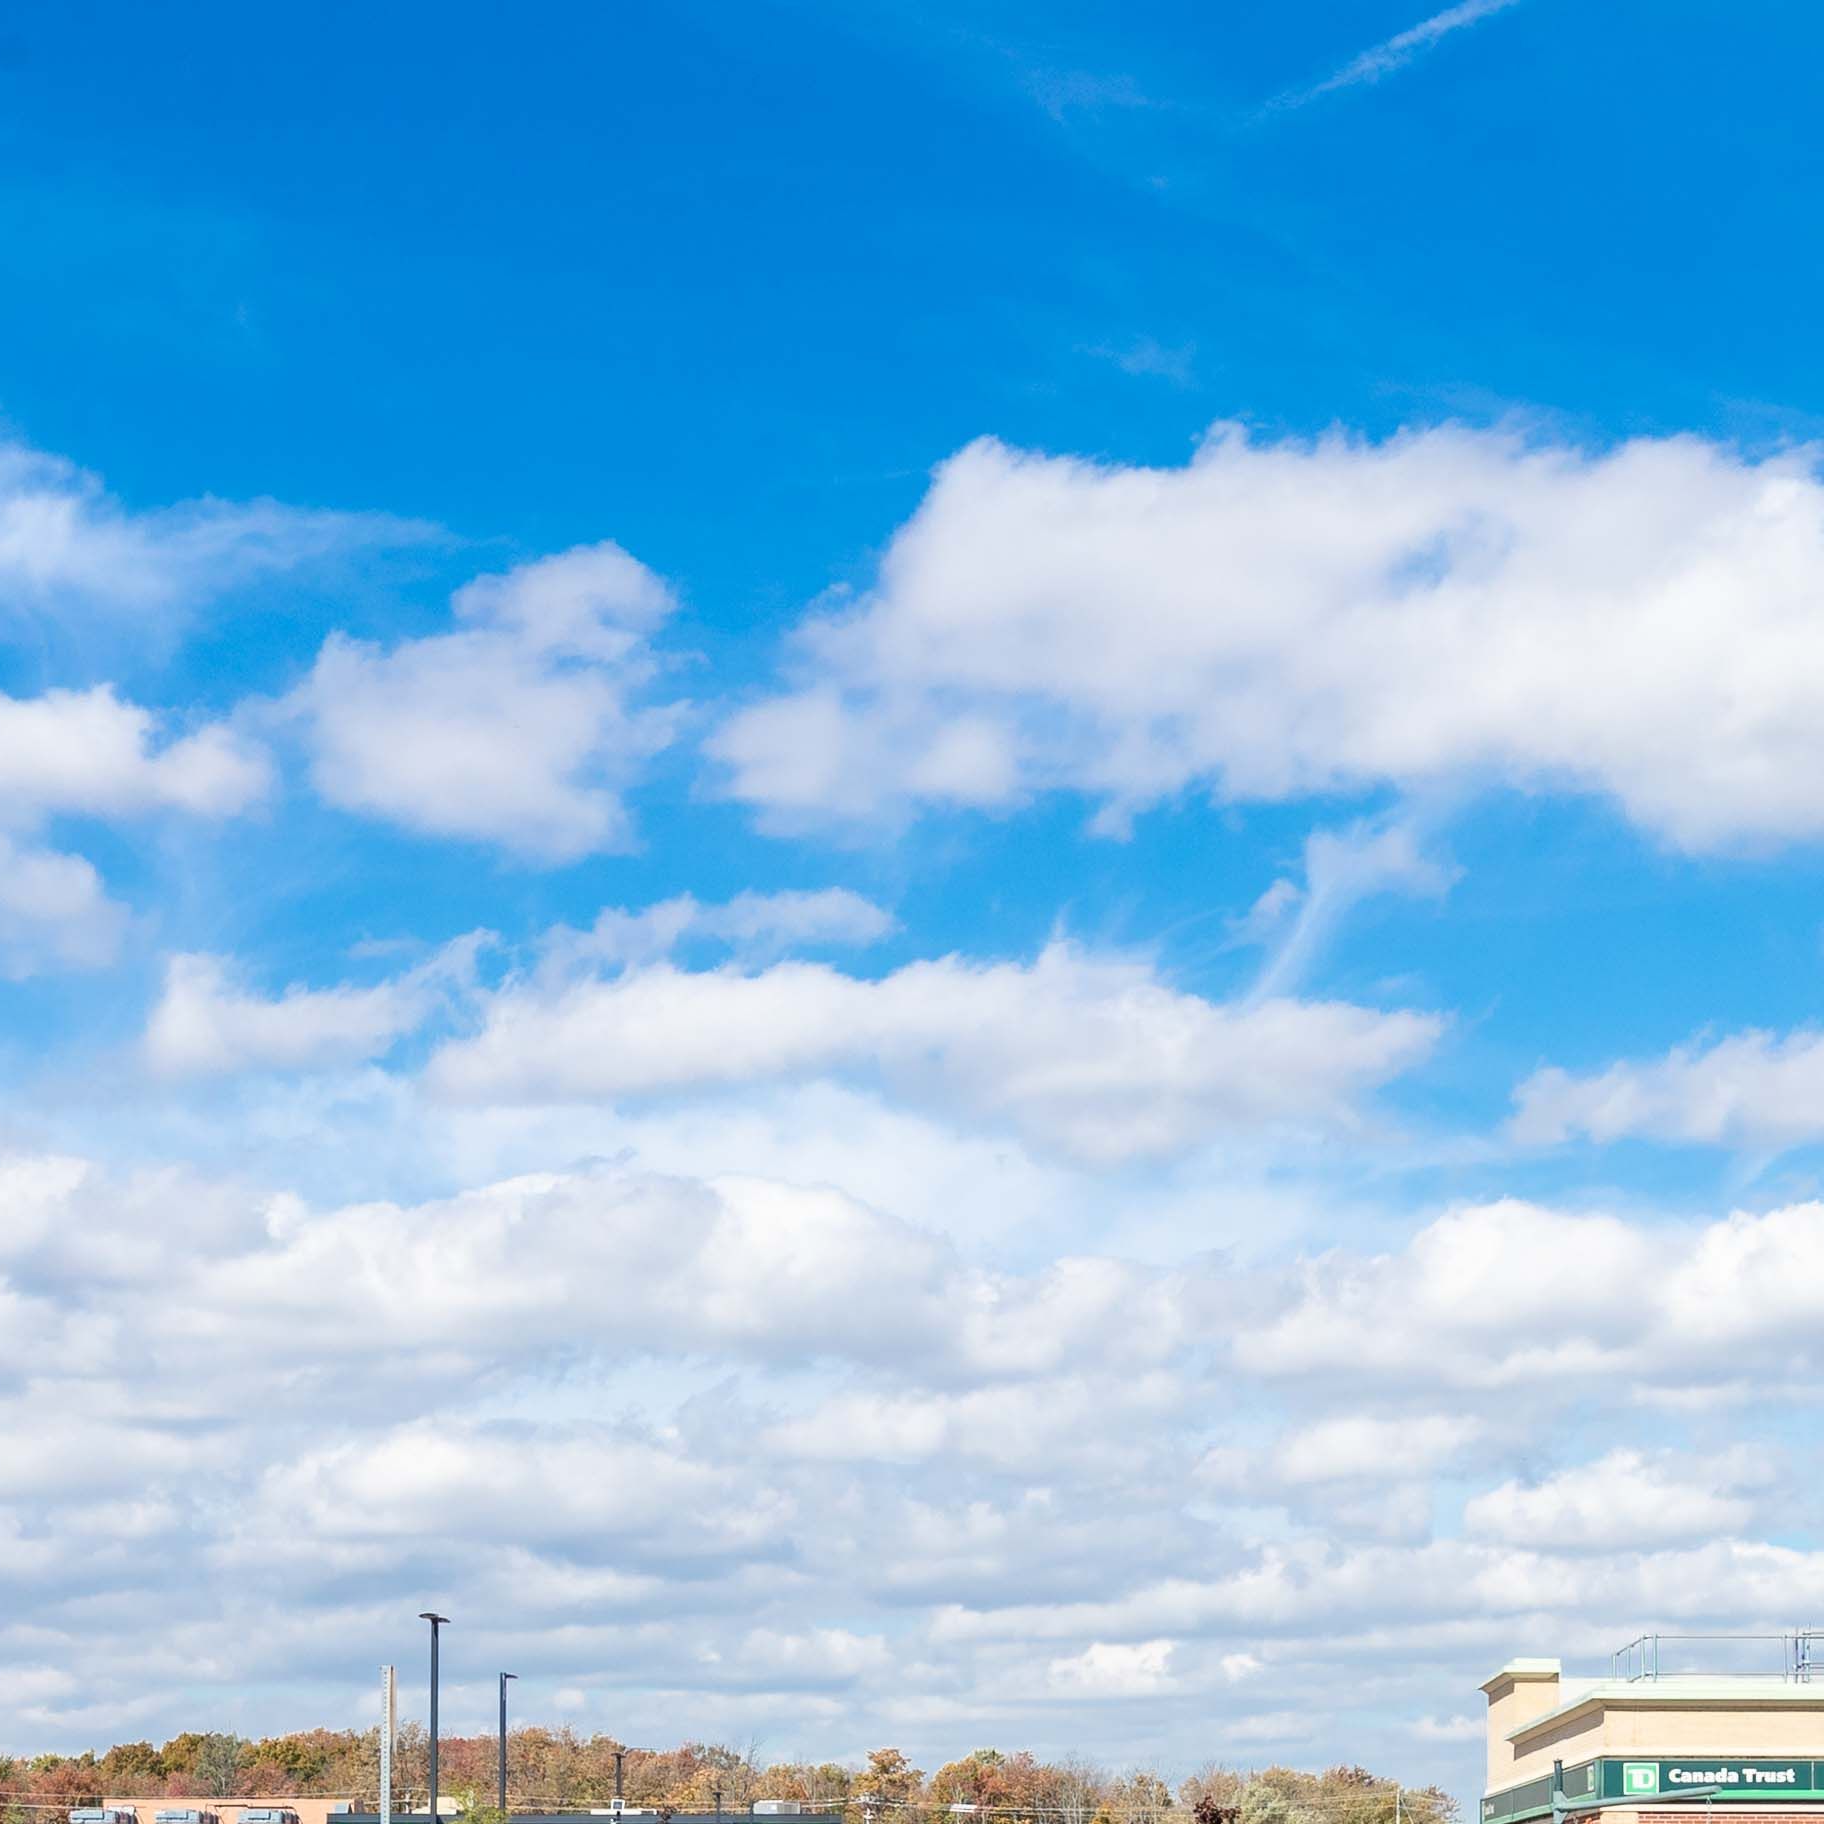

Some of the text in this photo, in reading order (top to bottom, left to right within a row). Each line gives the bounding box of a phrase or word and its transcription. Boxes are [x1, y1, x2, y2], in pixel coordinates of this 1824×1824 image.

[1627, 1768, 1796, 1789] TD Canada Trust
